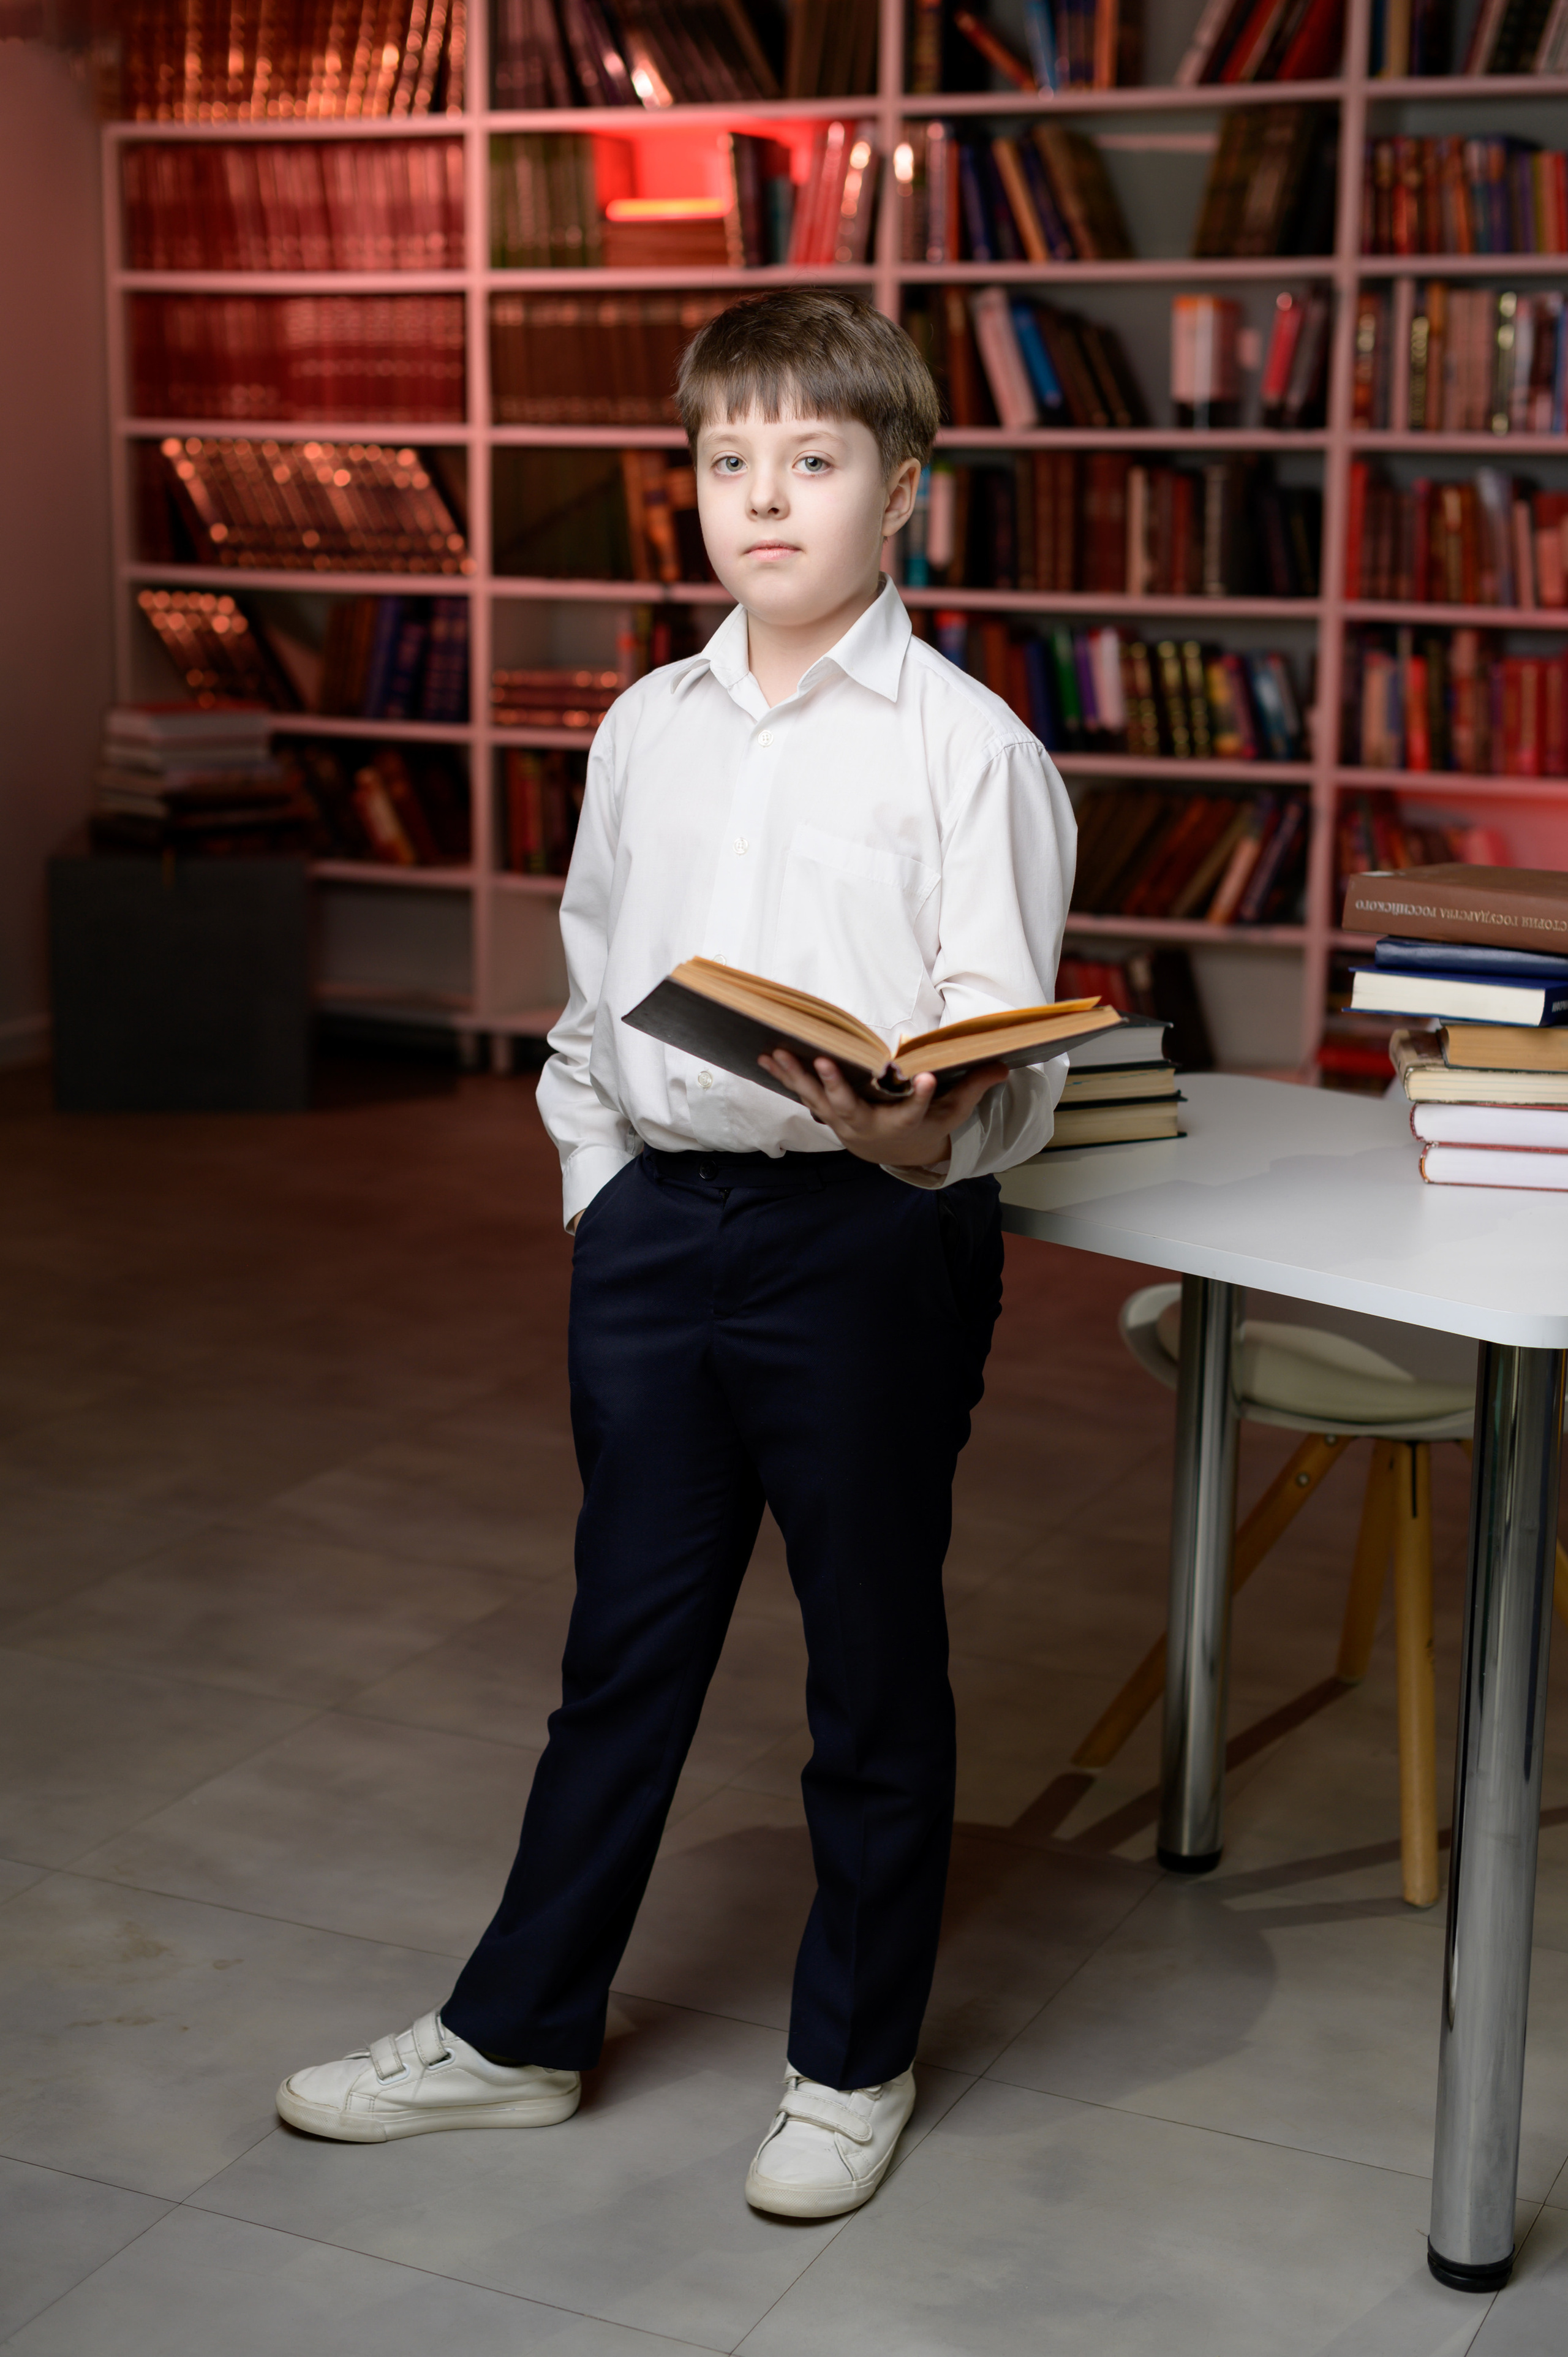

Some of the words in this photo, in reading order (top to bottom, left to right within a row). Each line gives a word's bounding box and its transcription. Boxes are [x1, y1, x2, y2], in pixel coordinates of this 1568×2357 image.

[1355, 899, 1437, 918] РОССИЙСКОГО
[1440, 907, 1518, 927] ГОСУДАРСТВА
[1521, 916, 1568, 932] СТОРИЯ
